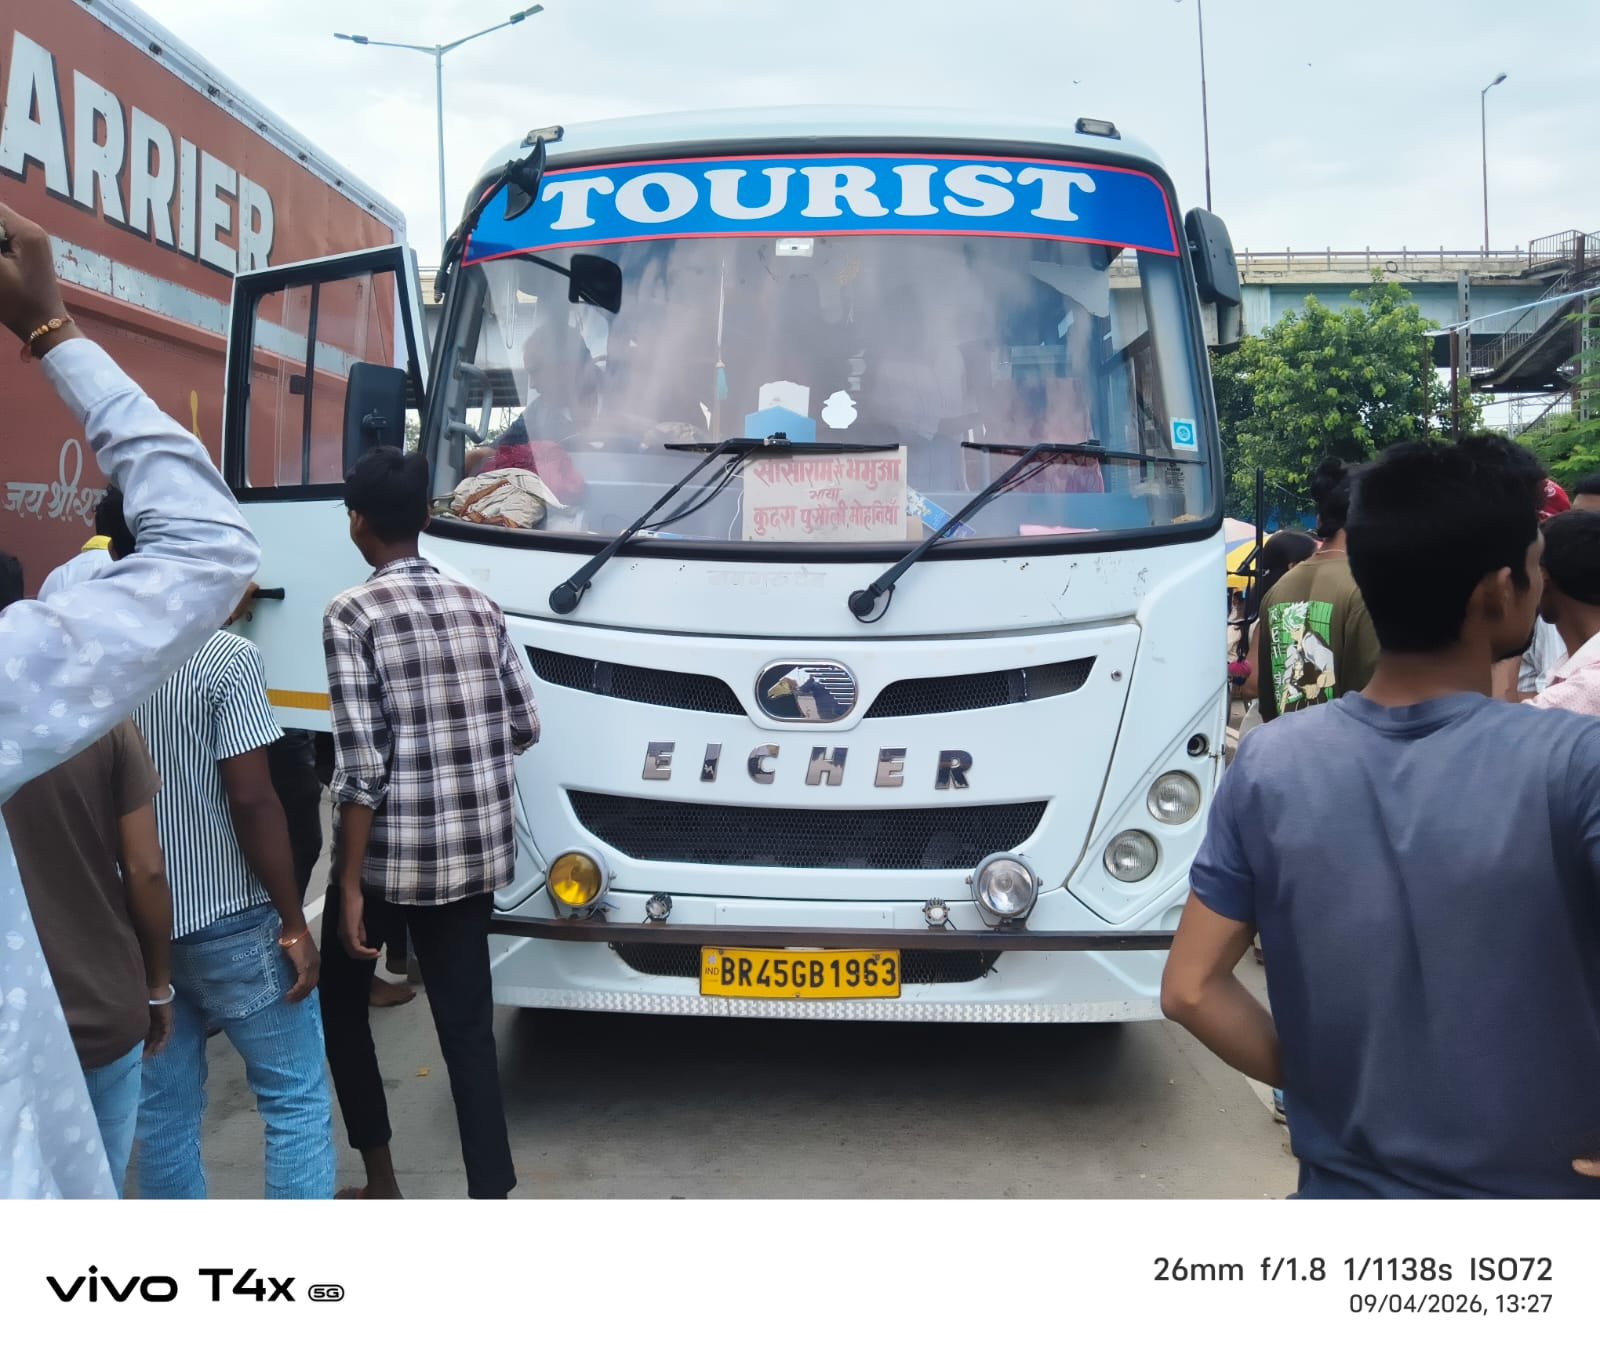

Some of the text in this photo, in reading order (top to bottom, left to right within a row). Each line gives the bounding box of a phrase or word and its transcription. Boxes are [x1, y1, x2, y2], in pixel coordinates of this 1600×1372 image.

[0, 30, 275, 273] ARRIER
[541, 164, 1096, 231] TOURIST
[4, 481, 48, 519] जय
[47, 438, 83, 521] श्री
[642, 740, 973, 790] EICHER
[705, 956, 897, 988] IND BR45GB1963
